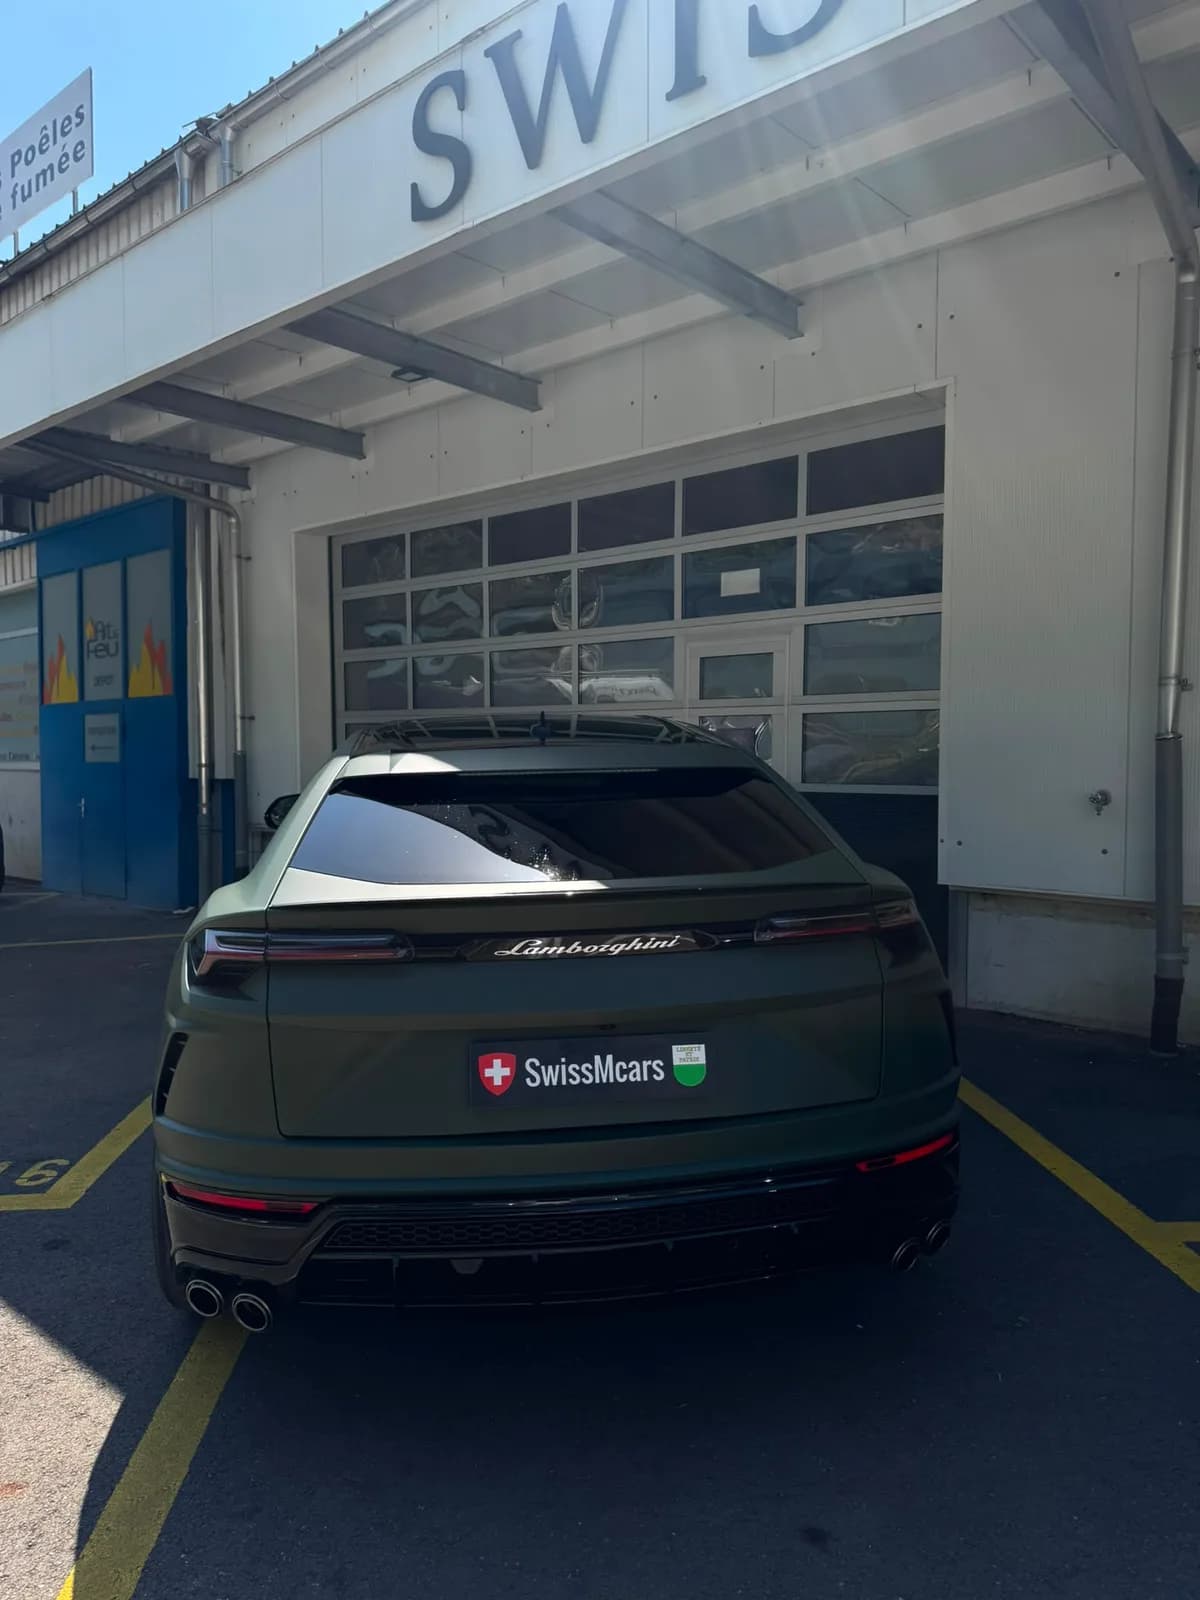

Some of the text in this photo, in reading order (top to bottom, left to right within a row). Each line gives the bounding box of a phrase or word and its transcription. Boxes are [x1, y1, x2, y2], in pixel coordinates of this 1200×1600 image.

[10, 104, 85, 179] Poêles
[10, 139, 86, 211] fumée
[494, 935, 681, 956] Lamborghini
[525, 1054, 665, 1087] SwissMcars
